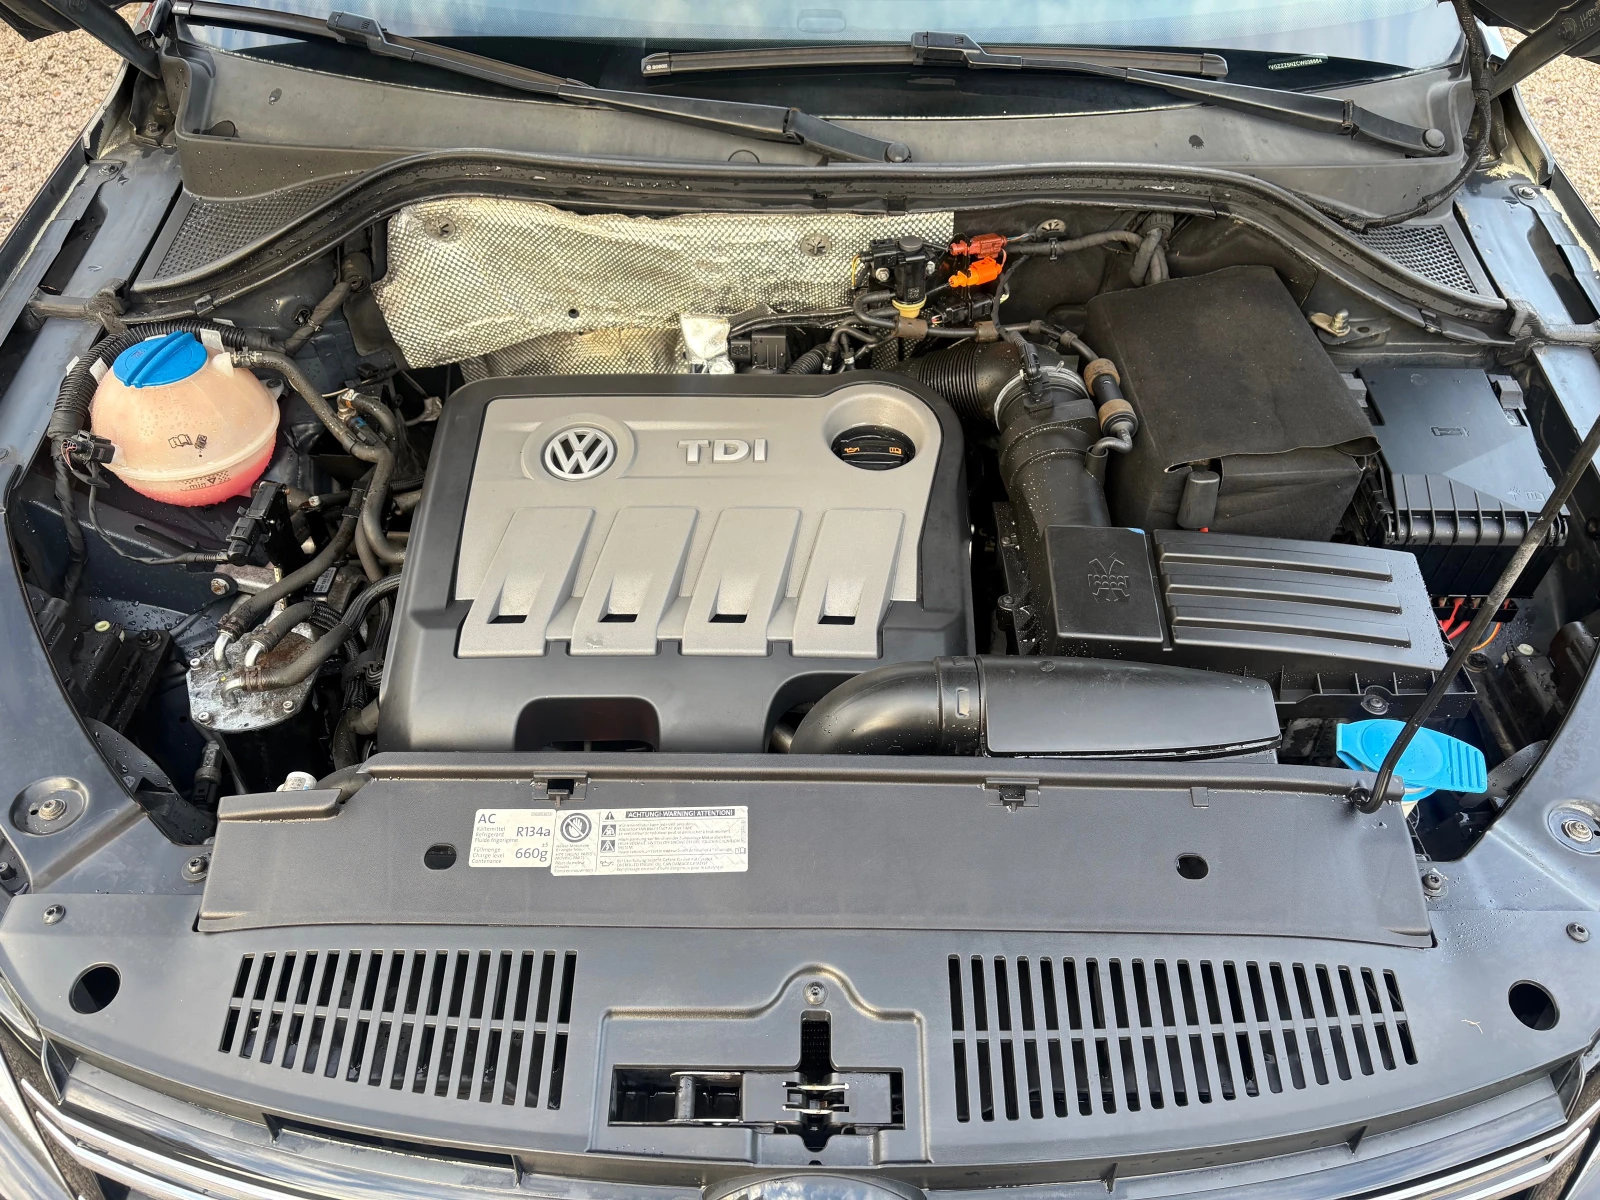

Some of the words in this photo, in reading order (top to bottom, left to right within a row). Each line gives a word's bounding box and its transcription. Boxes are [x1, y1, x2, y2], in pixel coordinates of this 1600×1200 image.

[677, 438, 768, 464] TDI
[478, 813, 497, 824] AC
[516, 826, 551, 837] R134a
[516, 848, 548, 862] 660g
